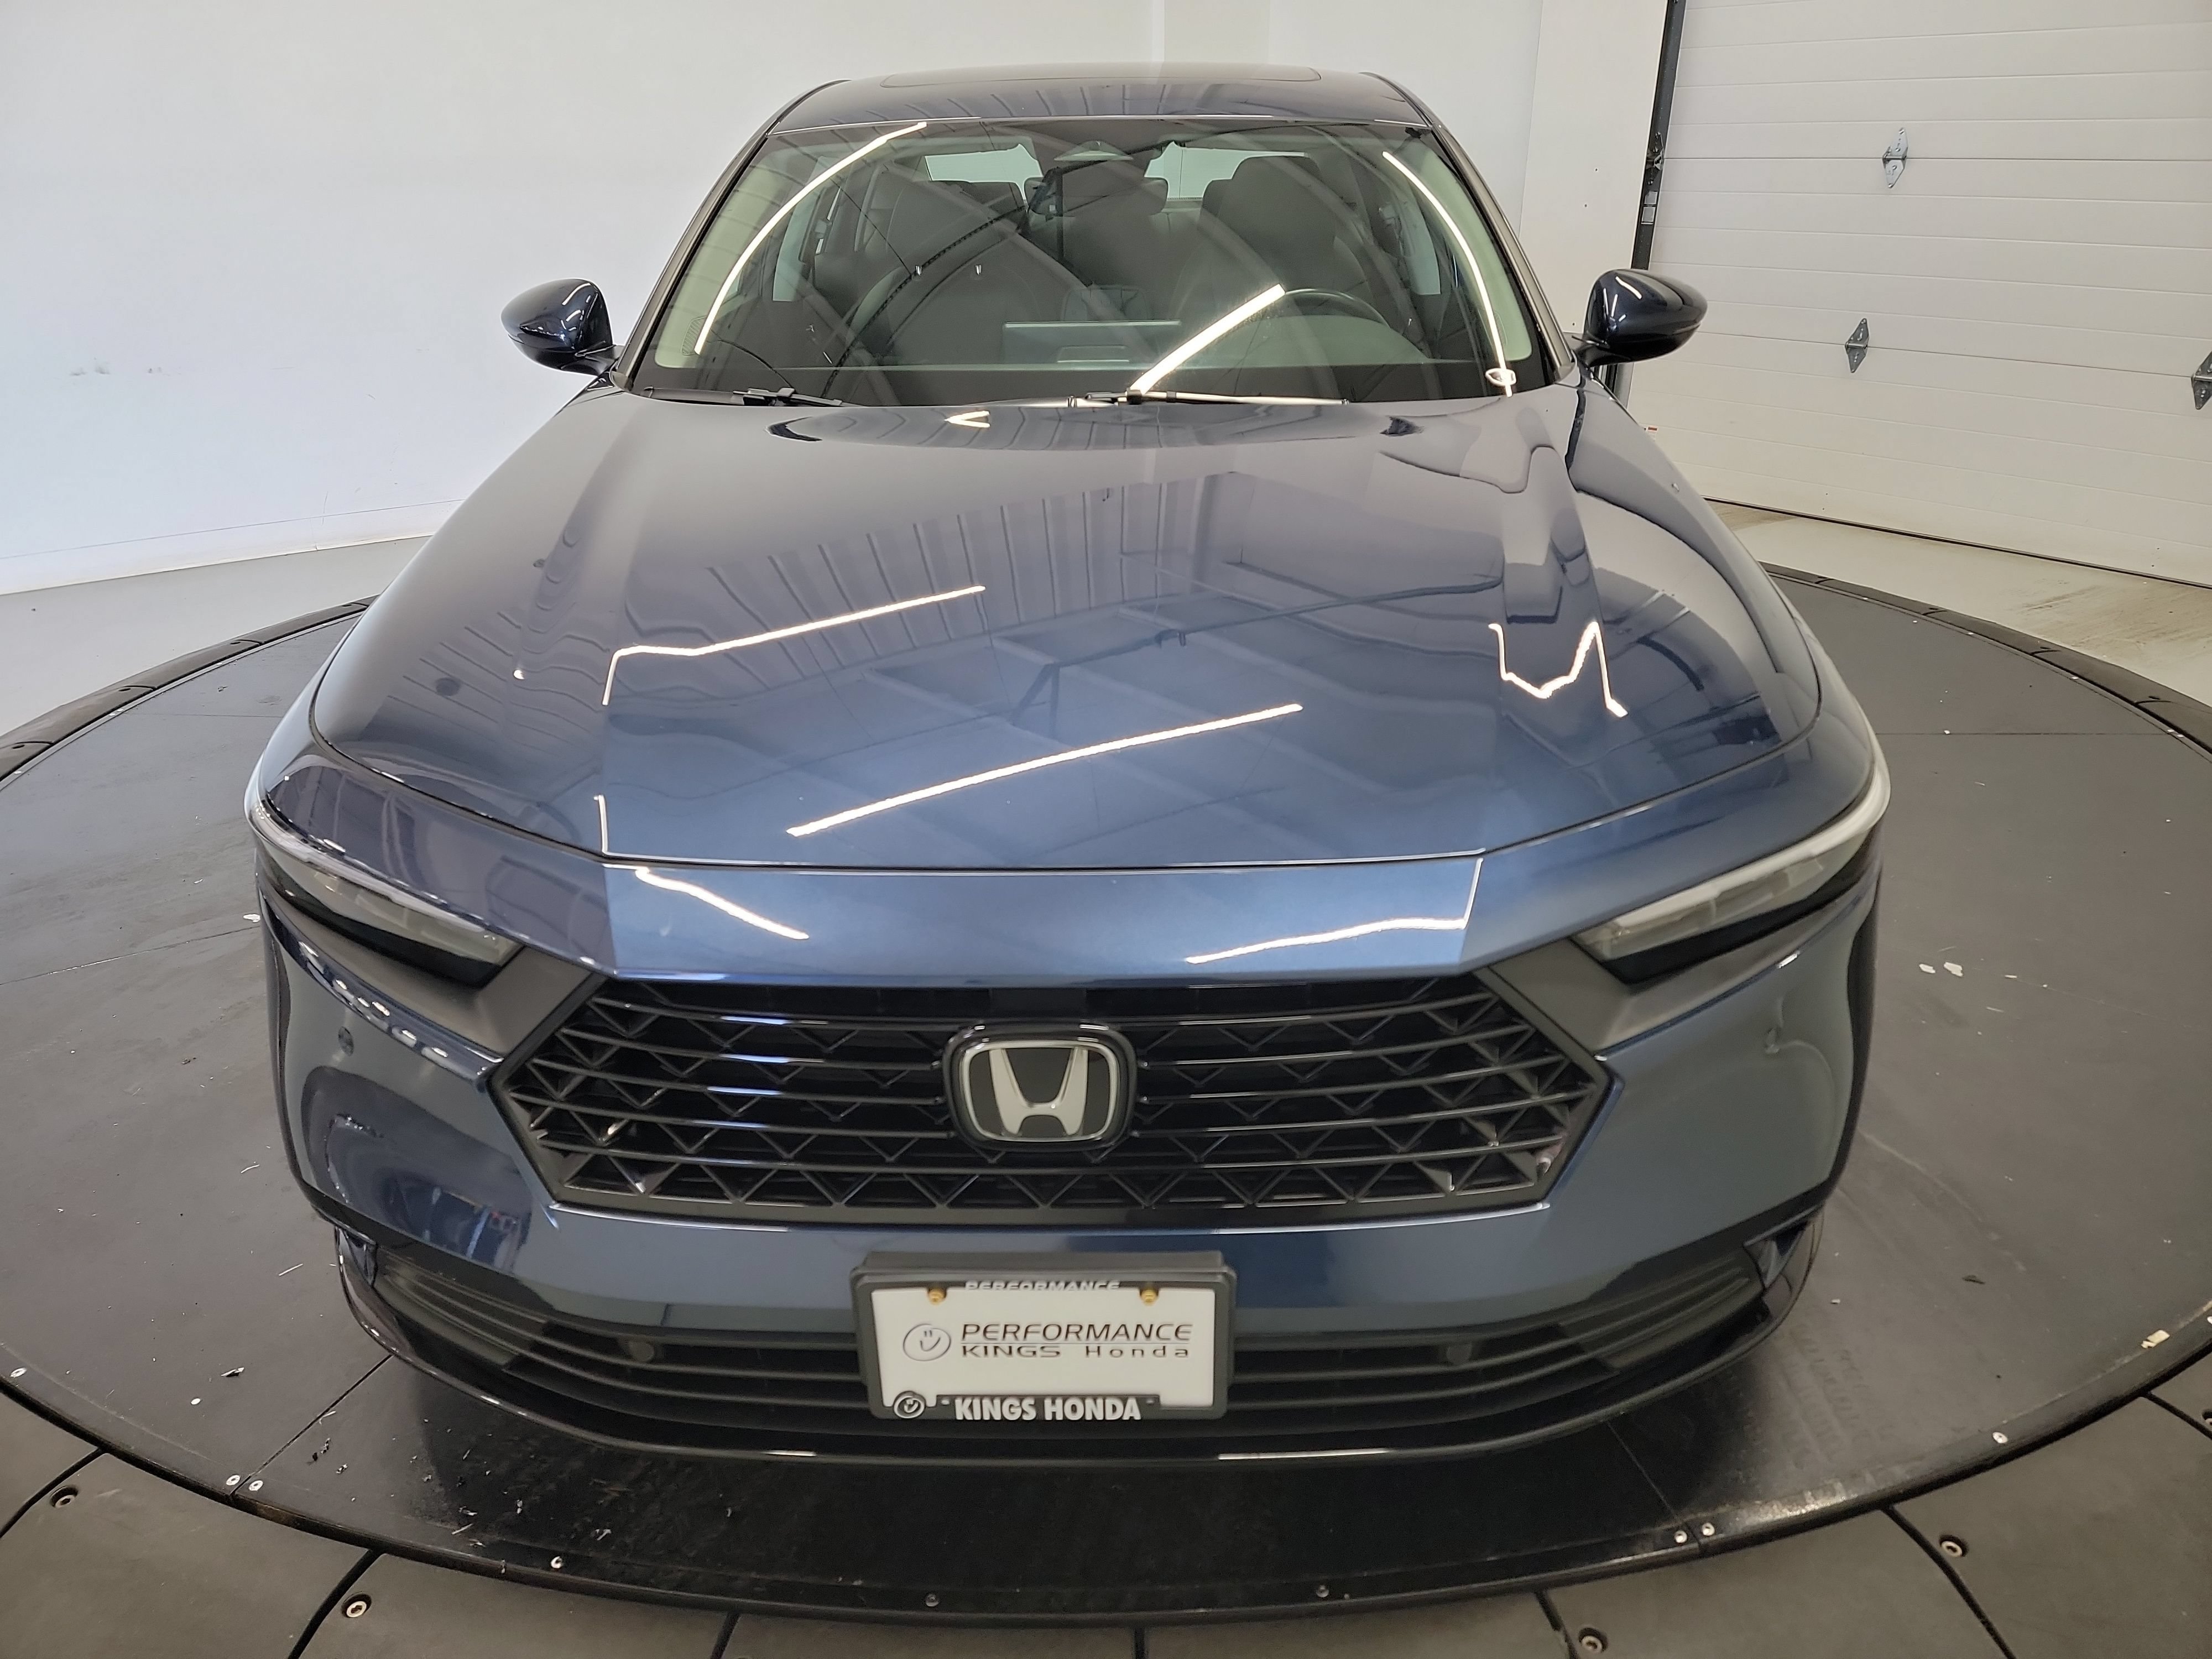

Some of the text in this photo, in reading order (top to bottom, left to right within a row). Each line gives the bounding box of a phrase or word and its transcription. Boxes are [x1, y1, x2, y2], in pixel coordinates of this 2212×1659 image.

[961, 1323, 1193, 1342] PERFORMANCE
[962, 1345, 1189, 1358] KINGS Honda
[954, 1397, 1142, 1421] KINGS HONDA
